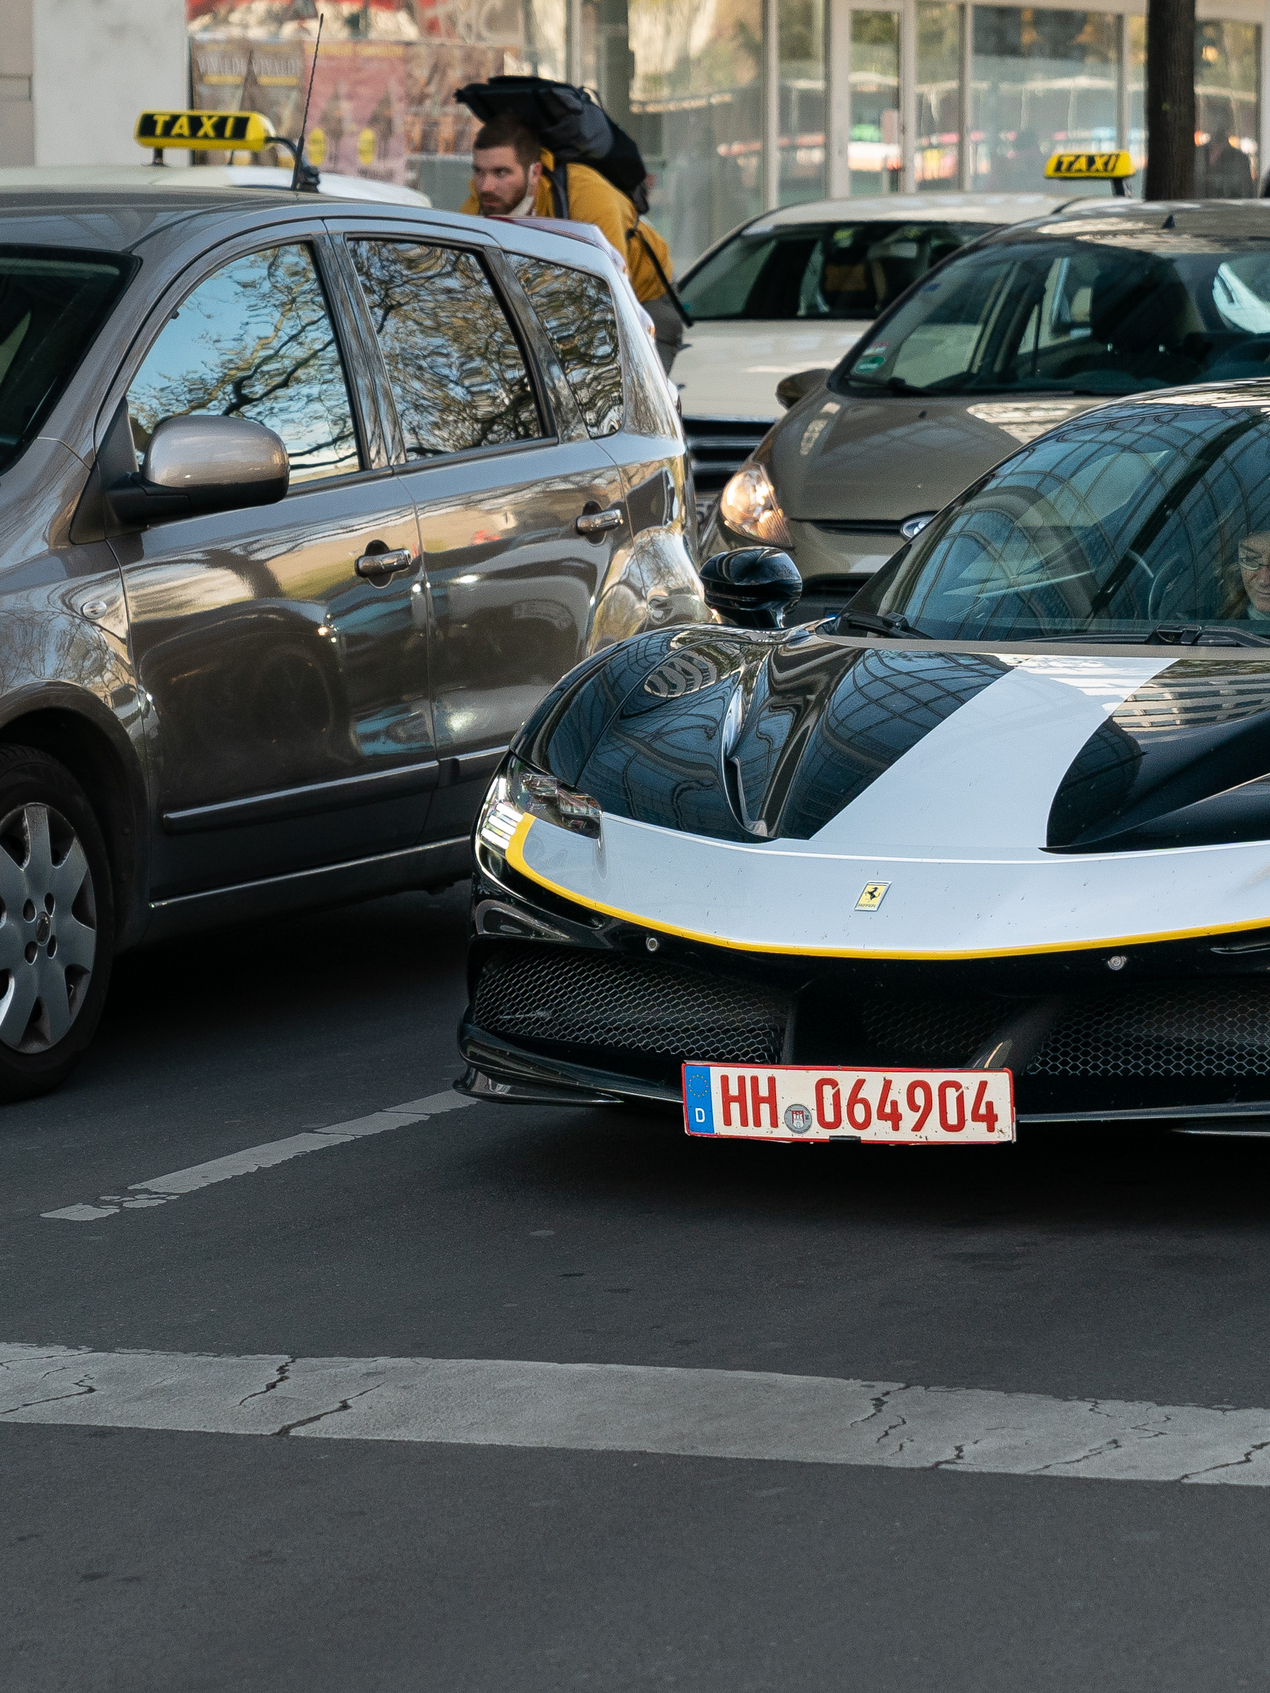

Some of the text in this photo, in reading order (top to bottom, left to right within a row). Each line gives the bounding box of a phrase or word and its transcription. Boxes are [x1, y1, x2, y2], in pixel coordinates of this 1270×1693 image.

[152, 114, 234, 138] TAXI
[1060, 155, 1117, 172] TAXI
[720, 1074, 998, 1132] HH 064904
[695, 1108, 705, 1122] D
